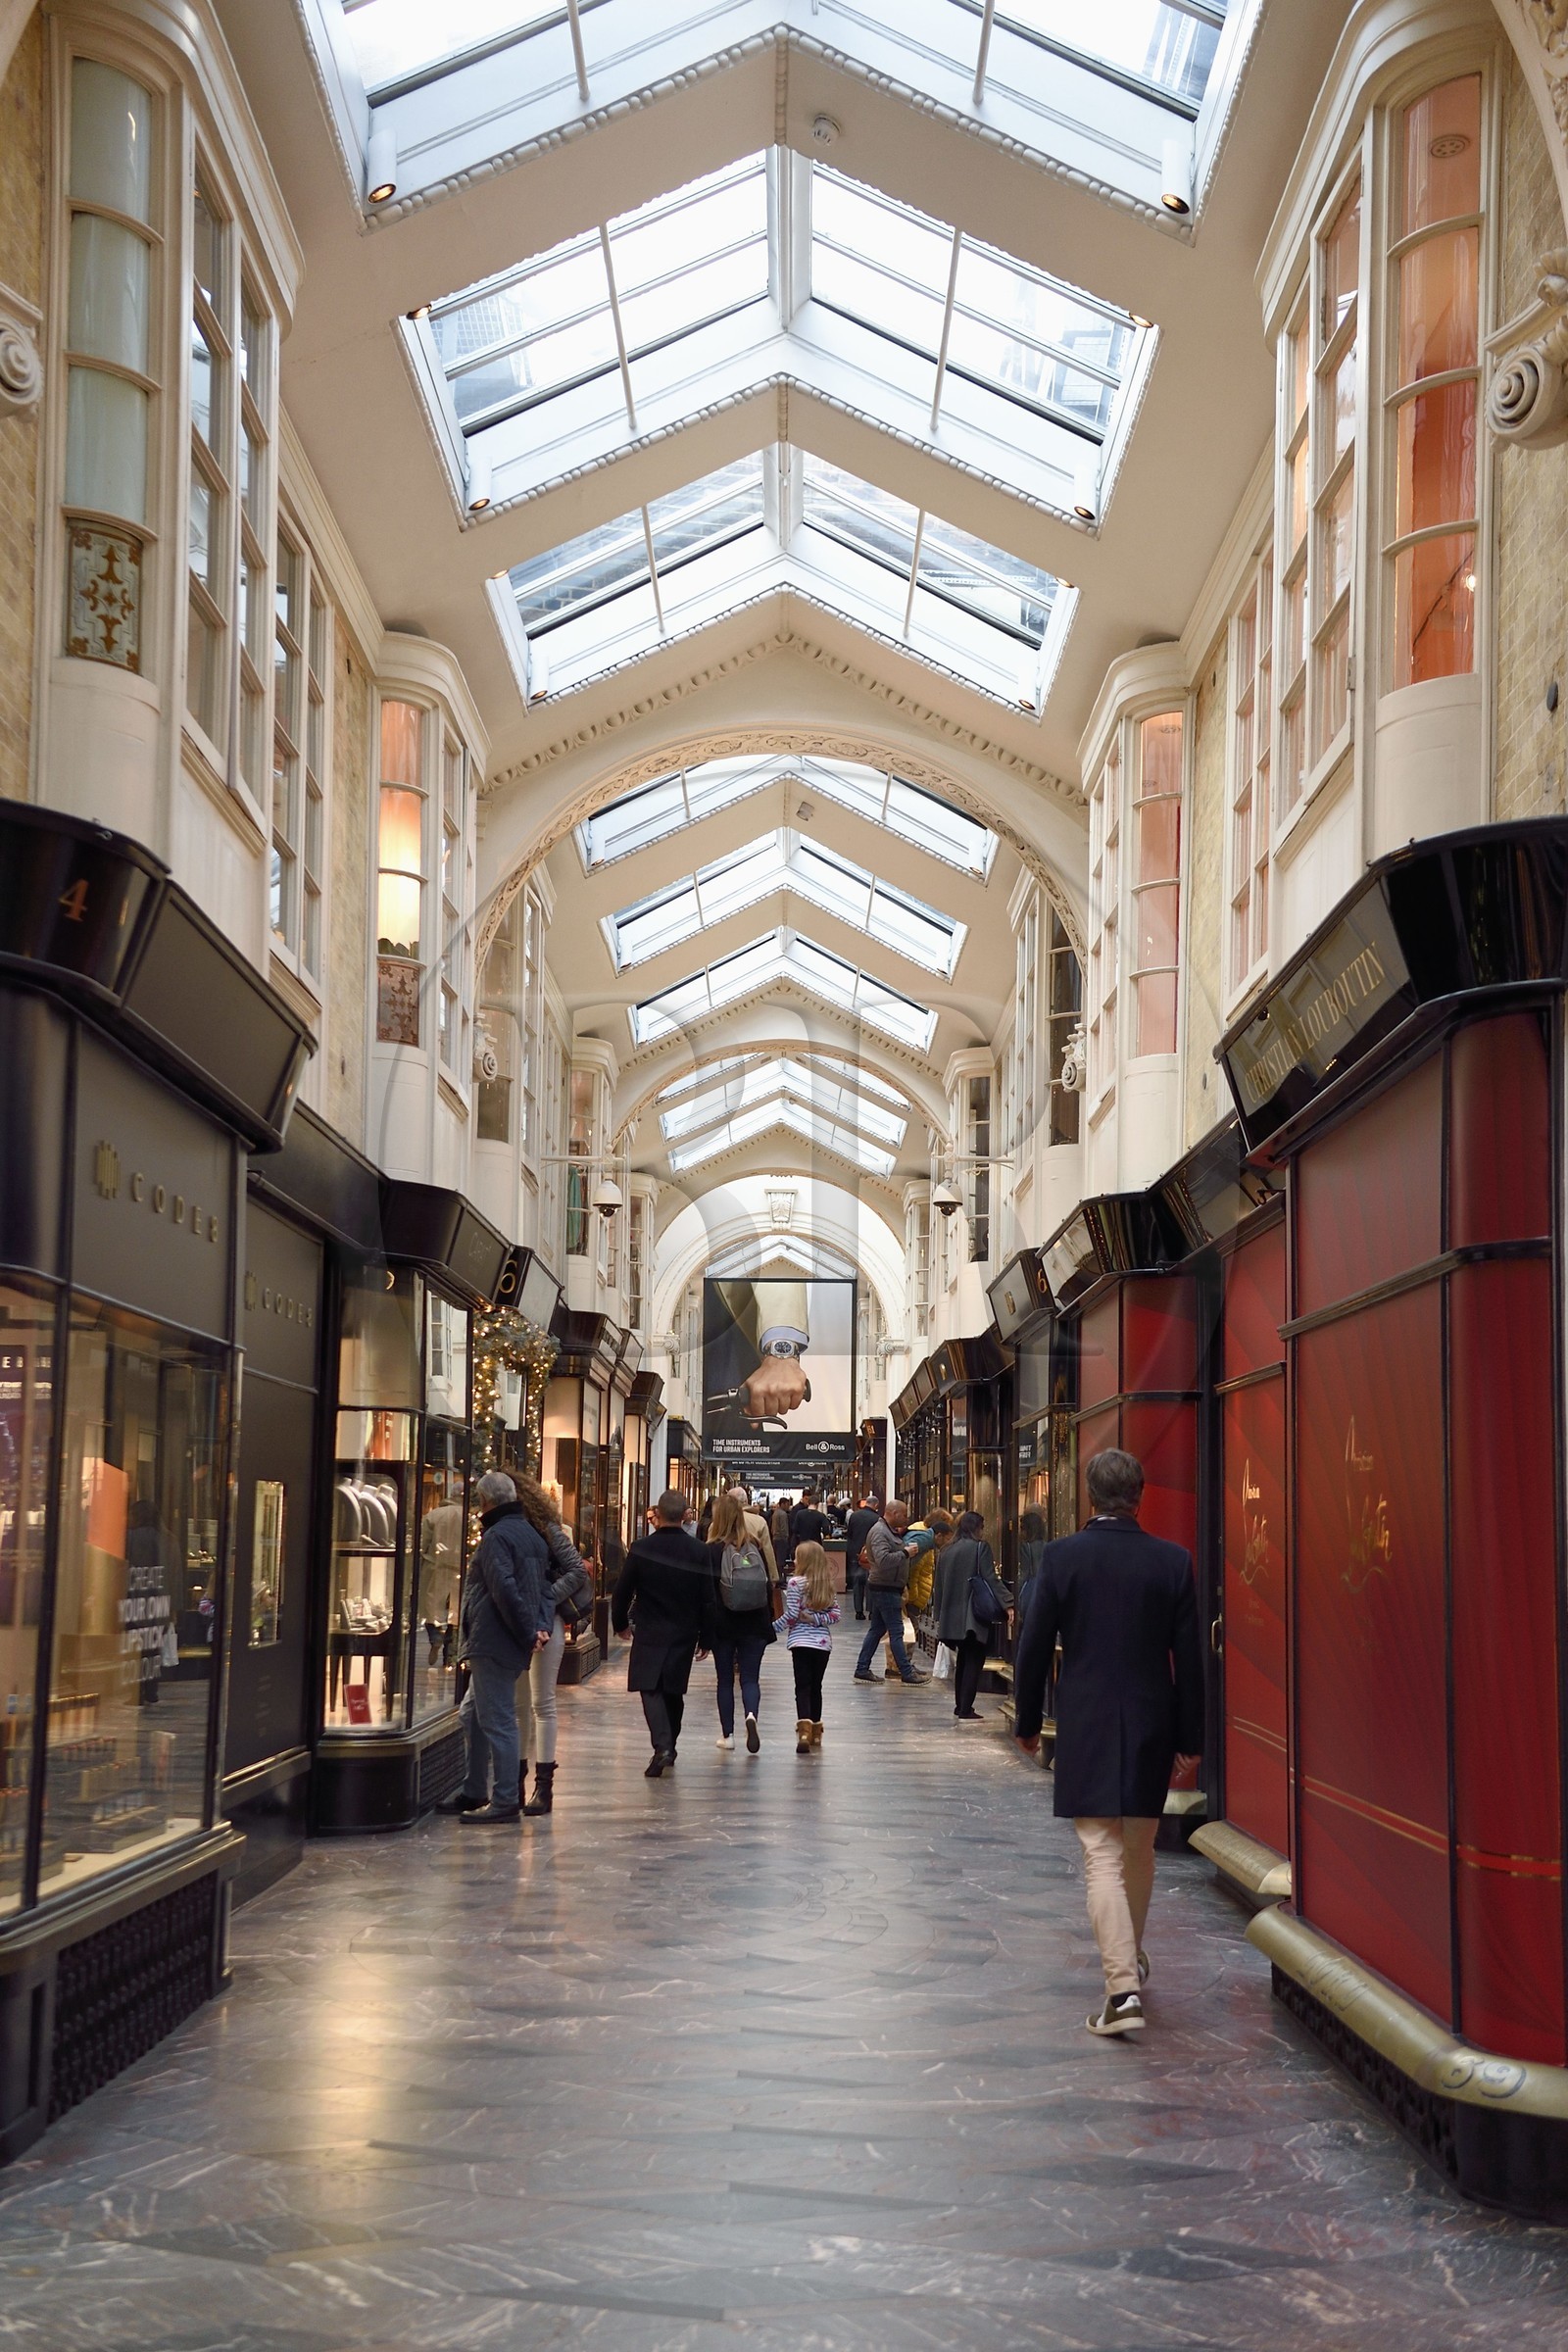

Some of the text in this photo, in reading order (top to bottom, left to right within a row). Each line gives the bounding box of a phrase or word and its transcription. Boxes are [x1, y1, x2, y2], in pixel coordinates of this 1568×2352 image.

[58, 878, 88, 922] 4
[1244, 941, 1386, 1104] CHRISTIAN LOUBOUTIN
[129, 1565, 165, 1591] CREATE
[119, 1594, 171, 1623] YOUR OWN
